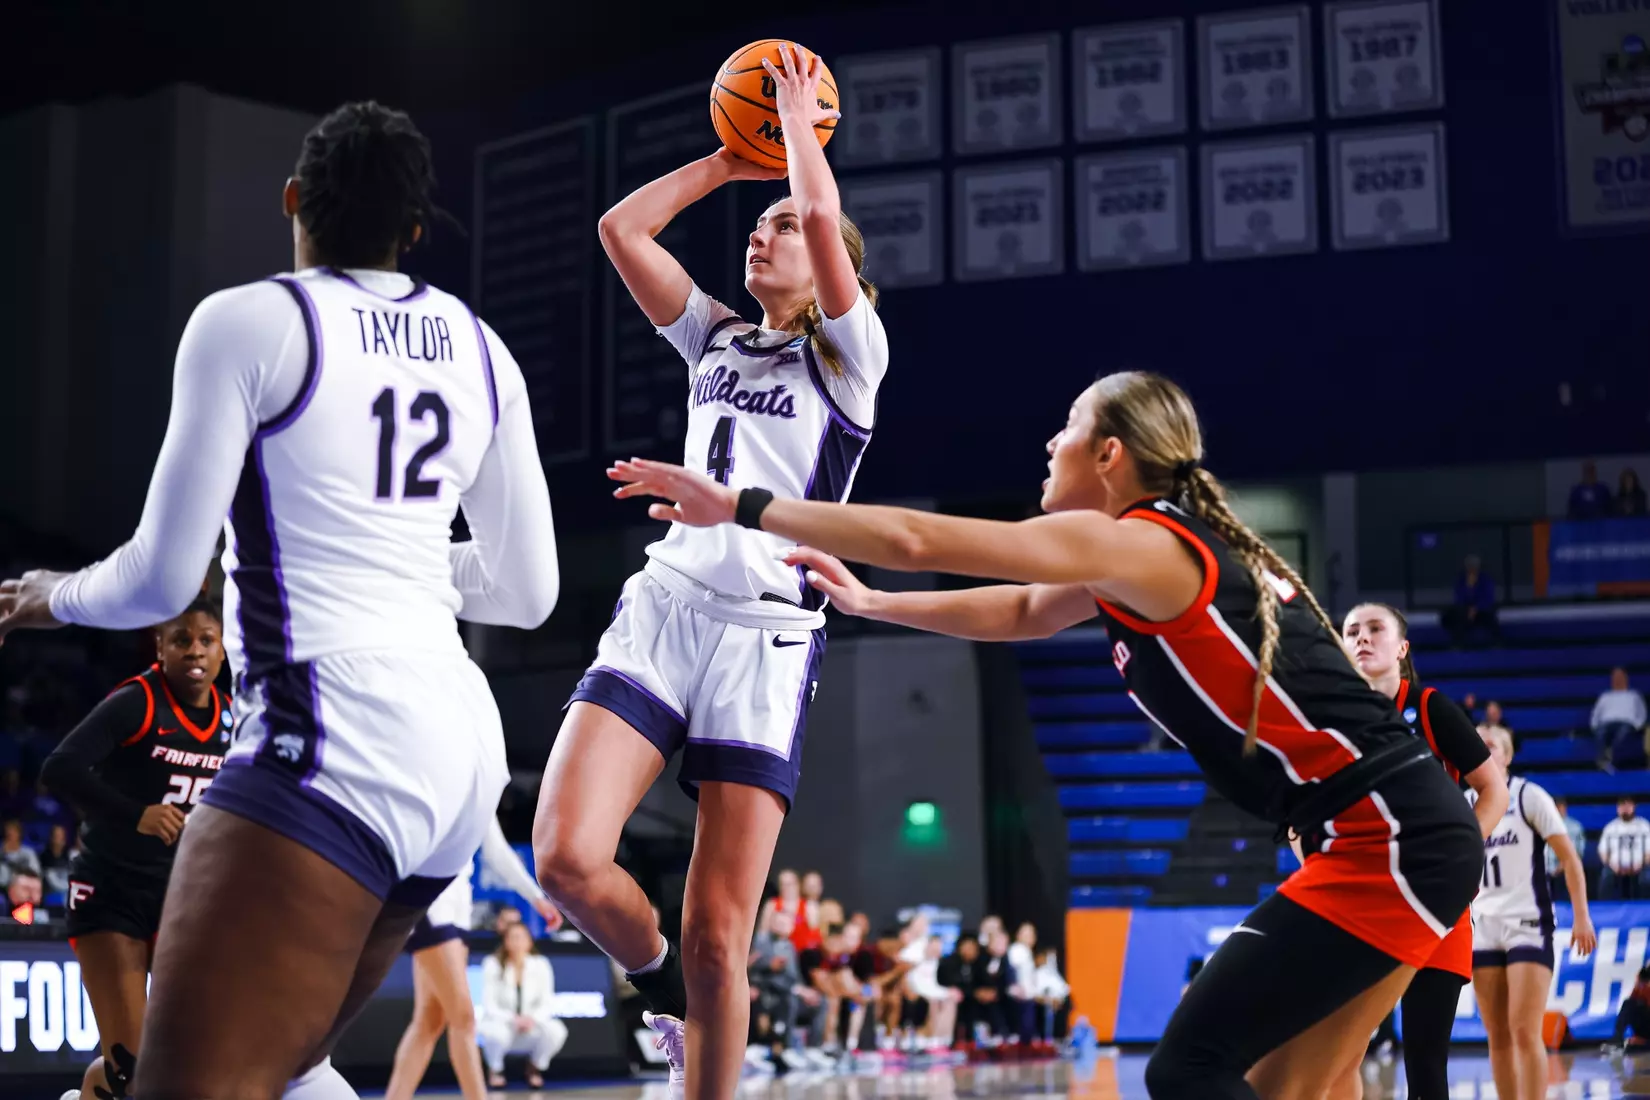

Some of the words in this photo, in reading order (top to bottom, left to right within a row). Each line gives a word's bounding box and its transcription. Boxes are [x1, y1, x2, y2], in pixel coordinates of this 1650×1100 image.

[350, 307, 453, 362] TAYLOR
[369, 384, 452, 503] 12
[706, 415, 737, 486] 4
[69, 881, 94, 911] F
